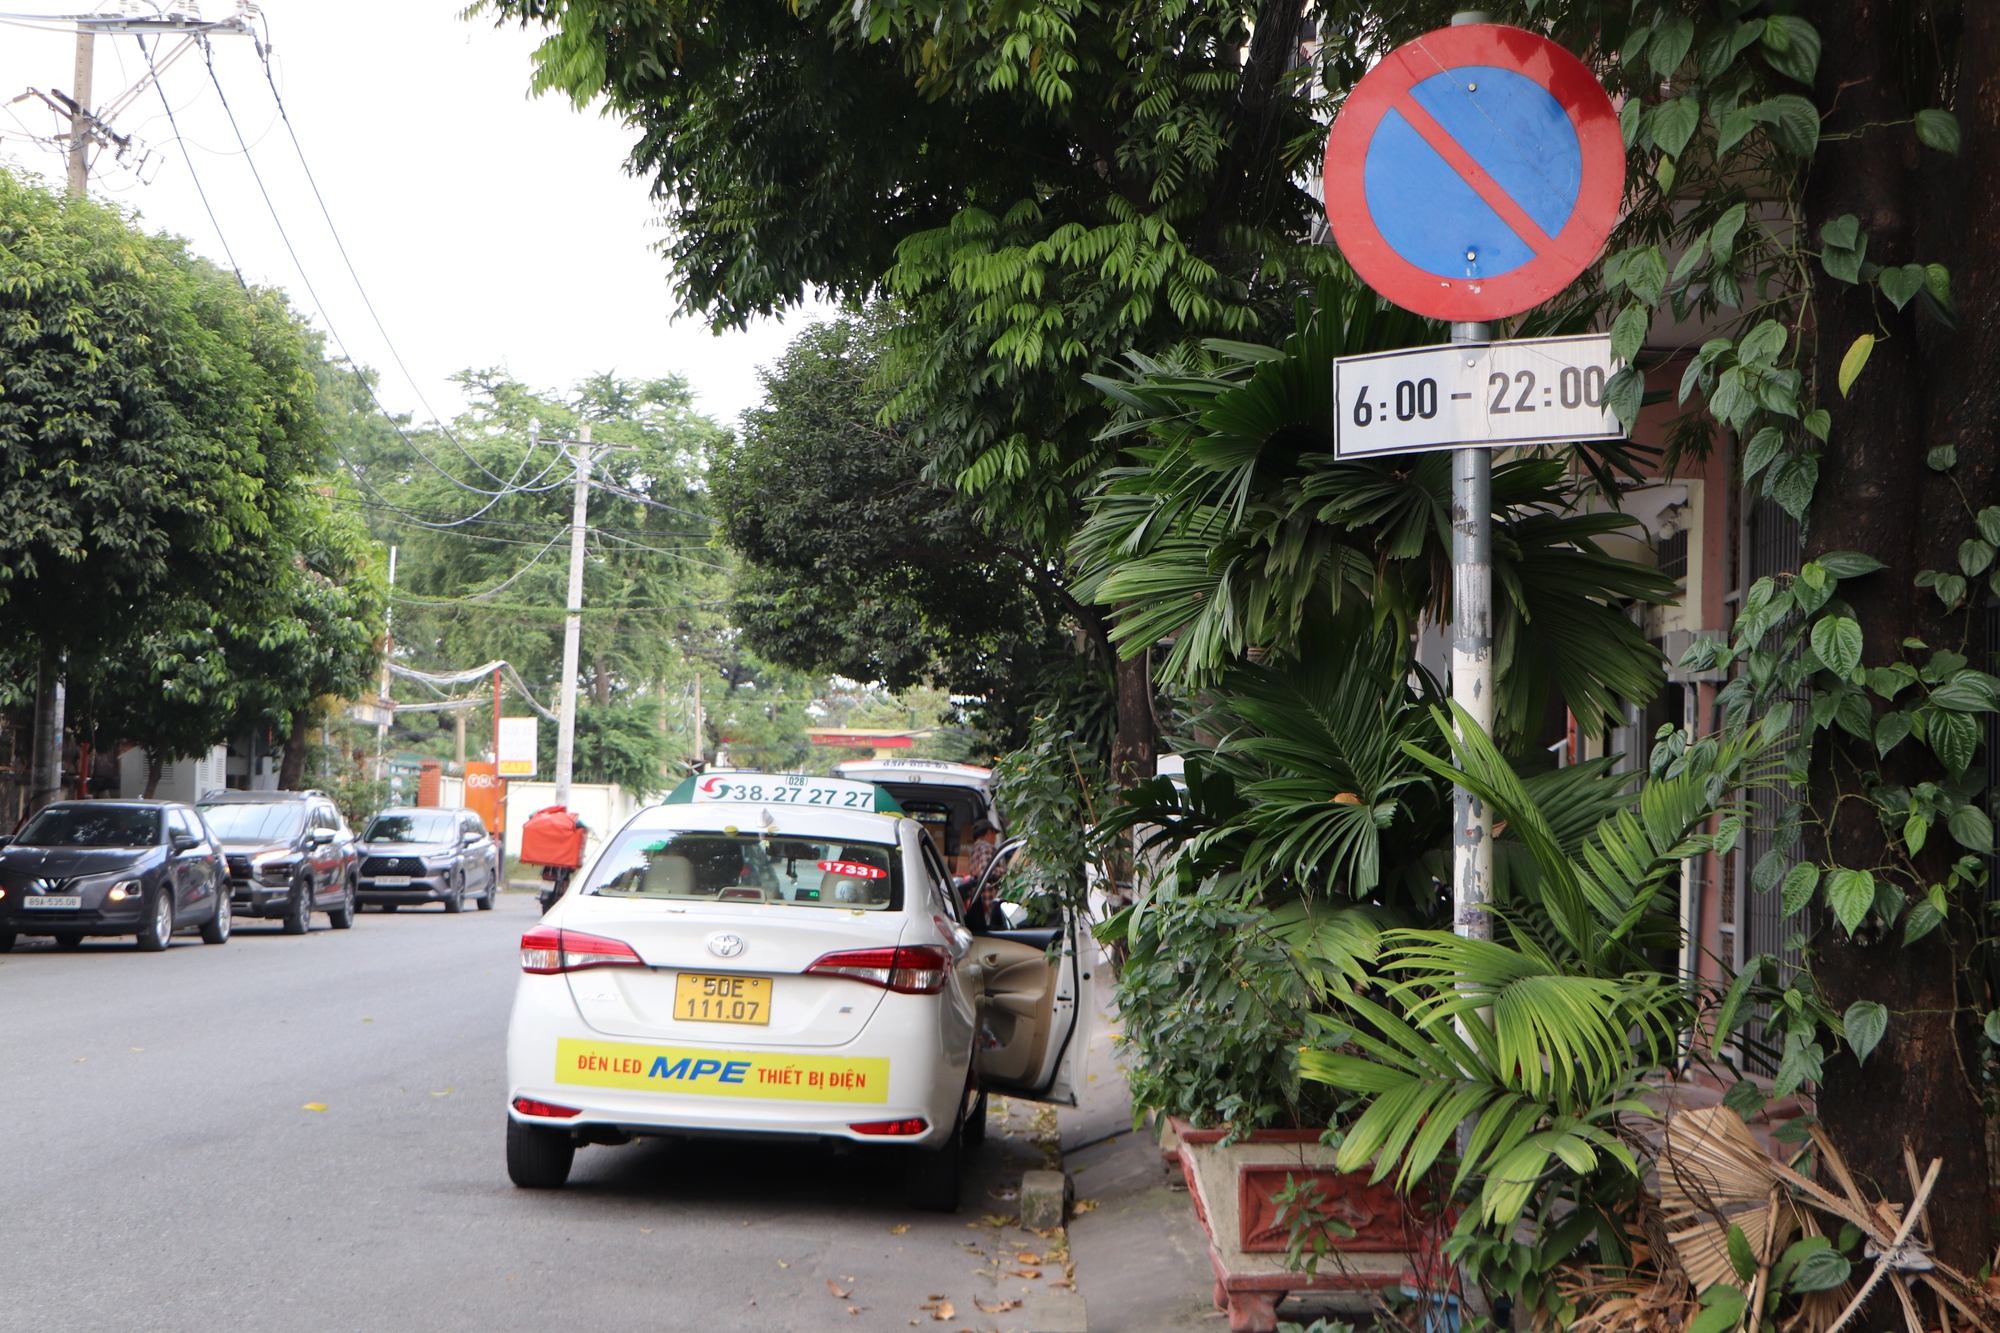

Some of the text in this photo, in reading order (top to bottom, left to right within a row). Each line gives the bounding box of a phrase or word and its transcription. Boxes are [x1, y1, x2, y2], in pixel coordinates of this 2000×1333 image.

[1353, 377, 1438, 428] 6:00
[1488, 365, 1606, 415] 22:00
[785, 776, 809, 787] (028)
[823, 862, 879, 878] 17331
[703, 977, 744, 998] 50E
[687, 998, 760, 1021] 111.07
[577, 1052, 866, 1090] ĐÈN LED MPE THIẾT BỊ ĐIỆN
